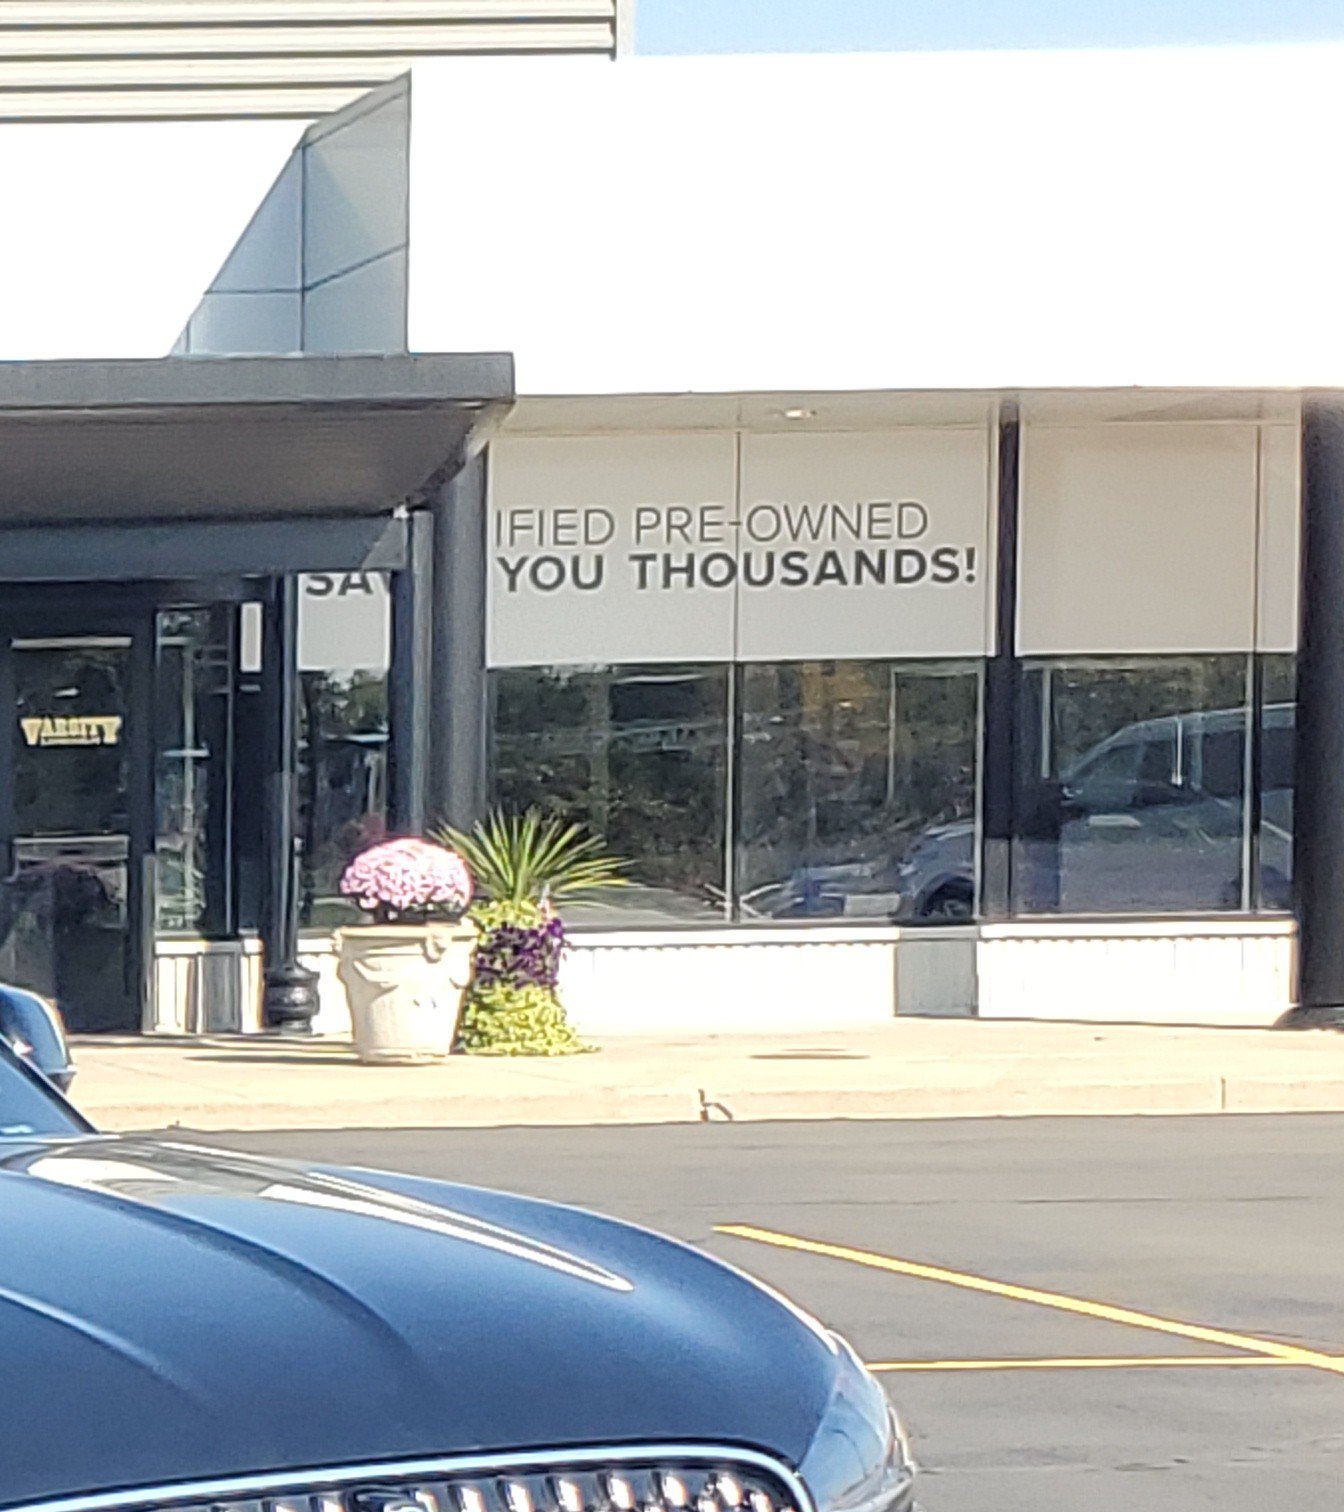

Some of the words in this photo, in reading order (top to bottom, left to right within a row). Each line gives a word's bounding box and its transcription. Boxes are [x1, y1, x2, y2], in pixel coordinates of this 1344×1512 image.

[495, 508, 615, 547] IFIED
[634, 501, 929, 544] PRE-OWNED
[305, 572, 390, 596] SA
[497, 555, 605, 592] YOU
[628, 547, 977, 590] THOUSANDS!
[20, 715, 122, 746] VARSITY
